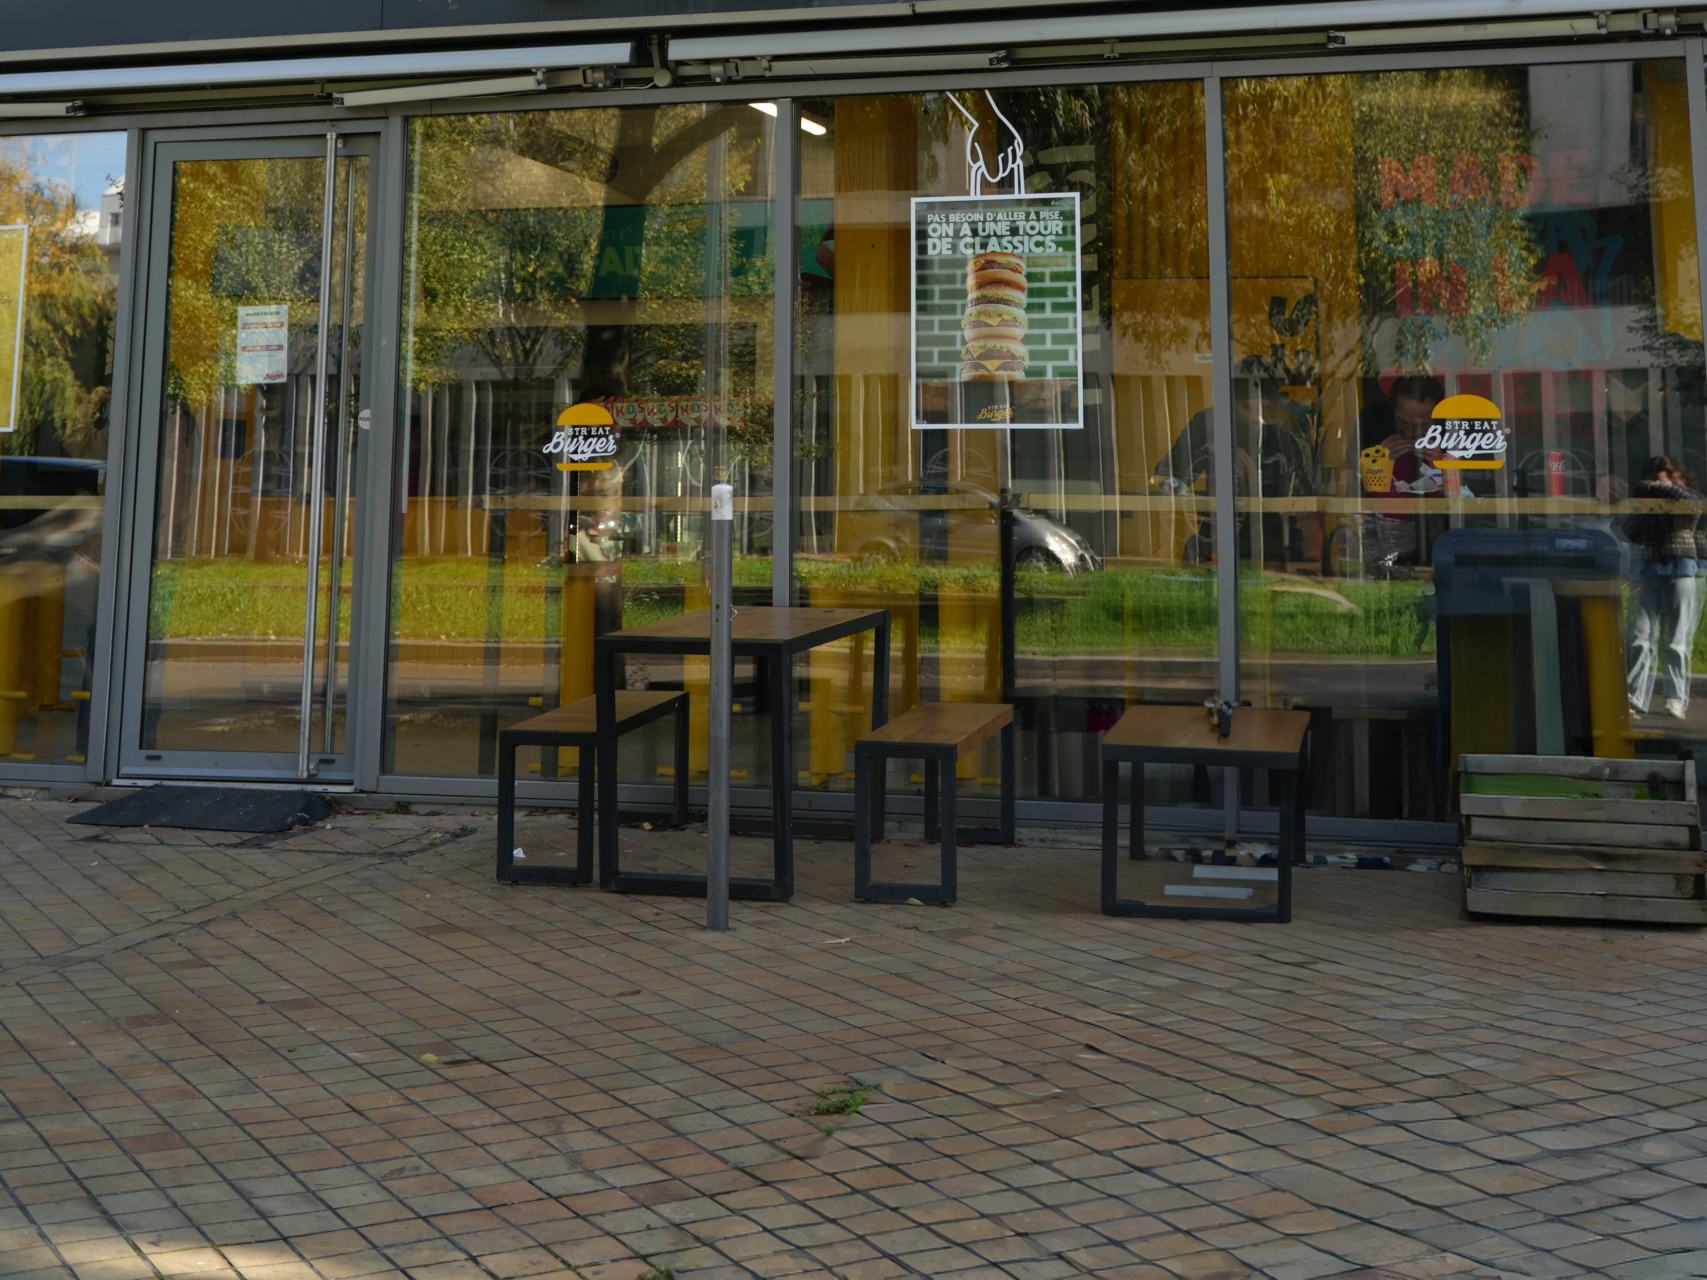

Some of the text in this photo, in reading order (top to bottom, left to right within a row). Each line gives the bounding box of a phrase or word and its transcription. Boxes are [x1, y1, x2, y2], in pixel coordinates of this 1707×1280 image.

[1379, 149, 1591, 209] MADE
[927, 209, 1064, 223] PAS BESOIN D'ALLER À PISE,
[927, 220, 1064, 237] ON A UNE TOUR
[927, 235, 1064, 256] DE CLASSICS.
[1394, 251, 1593, 318] IN LA
[1445, 420, 1498, 430] STR'EAT
[542, 431, 618, 462] Burger
[1413, 424, 1508, 459] Burger
